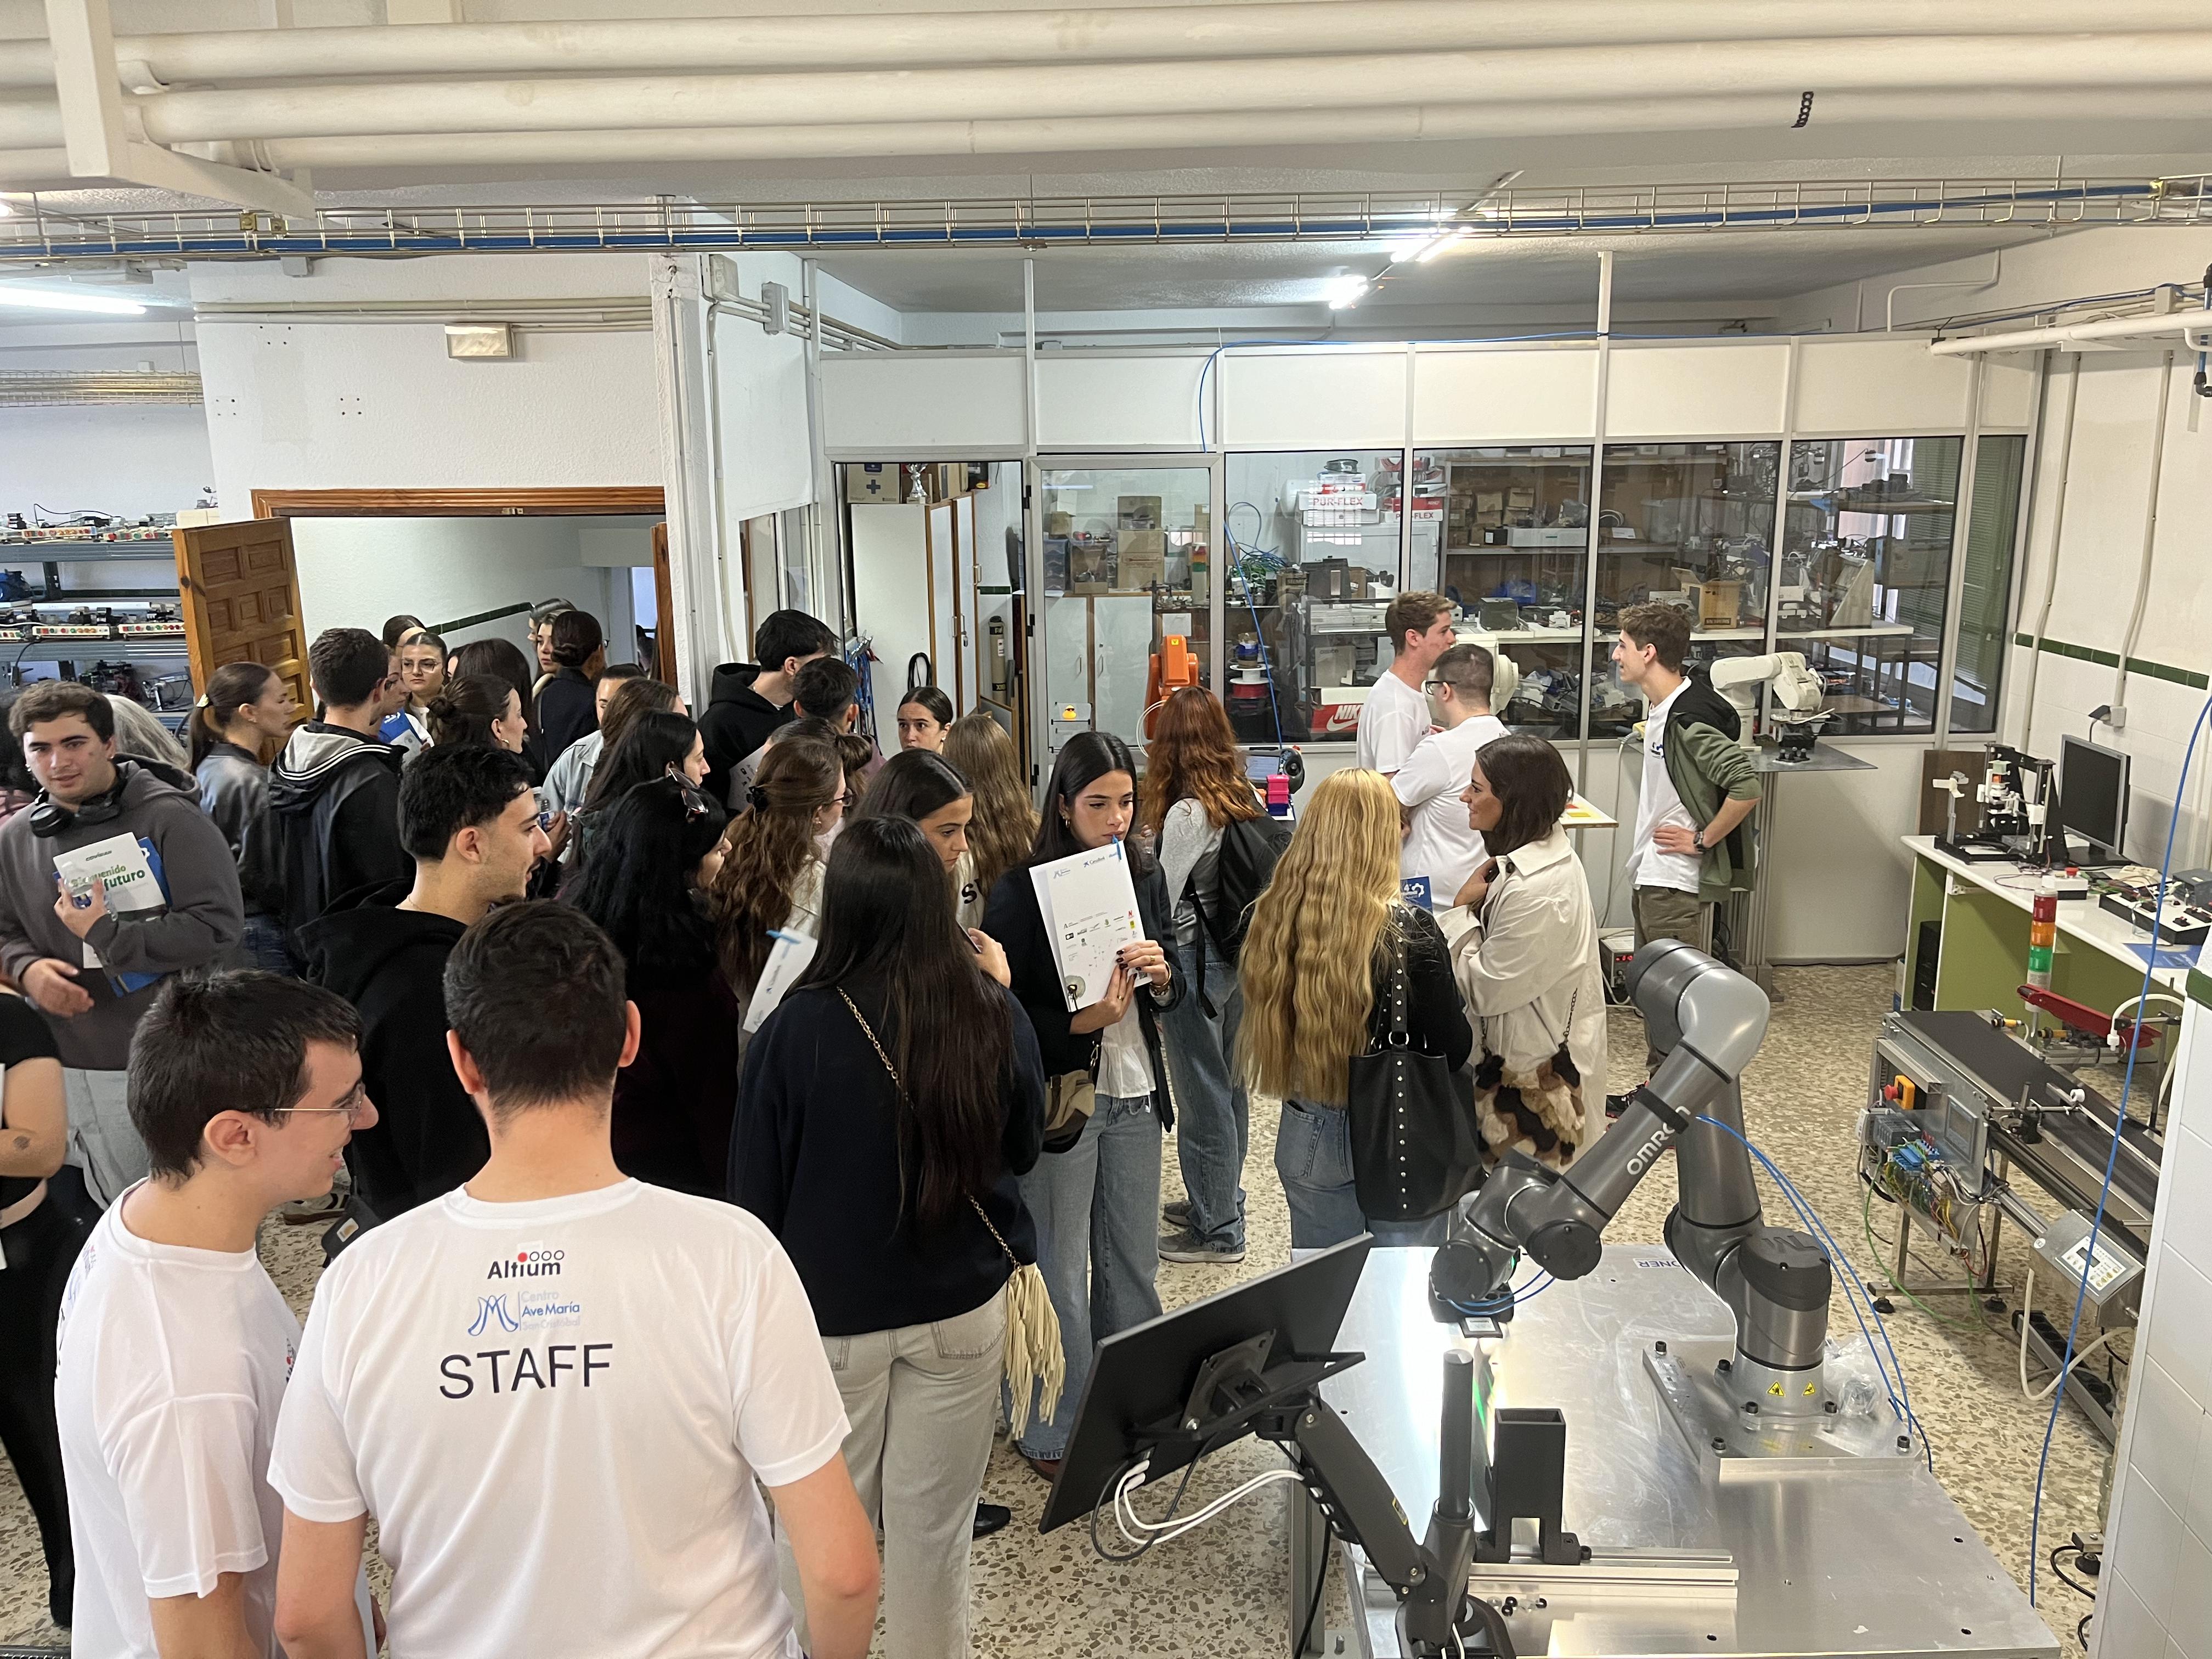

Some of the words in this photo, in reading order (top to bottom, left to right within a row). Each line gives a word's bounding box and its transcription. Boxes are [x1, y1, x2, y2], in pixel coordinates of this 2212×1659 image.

[1313, 497, 1363, 506] PUR-FLEX
[1333, 704, 1362, 720] NIK
[103, 870, 146, 891] futuro
[487, 1260, 561, 1280] Altium
[521, 1290, 560, 1303] Centro
[522, 1305, 544, 1318] Ave
[545, 1301, 580, 1316] María
[439, 1343, 613, 1400] STAFF
